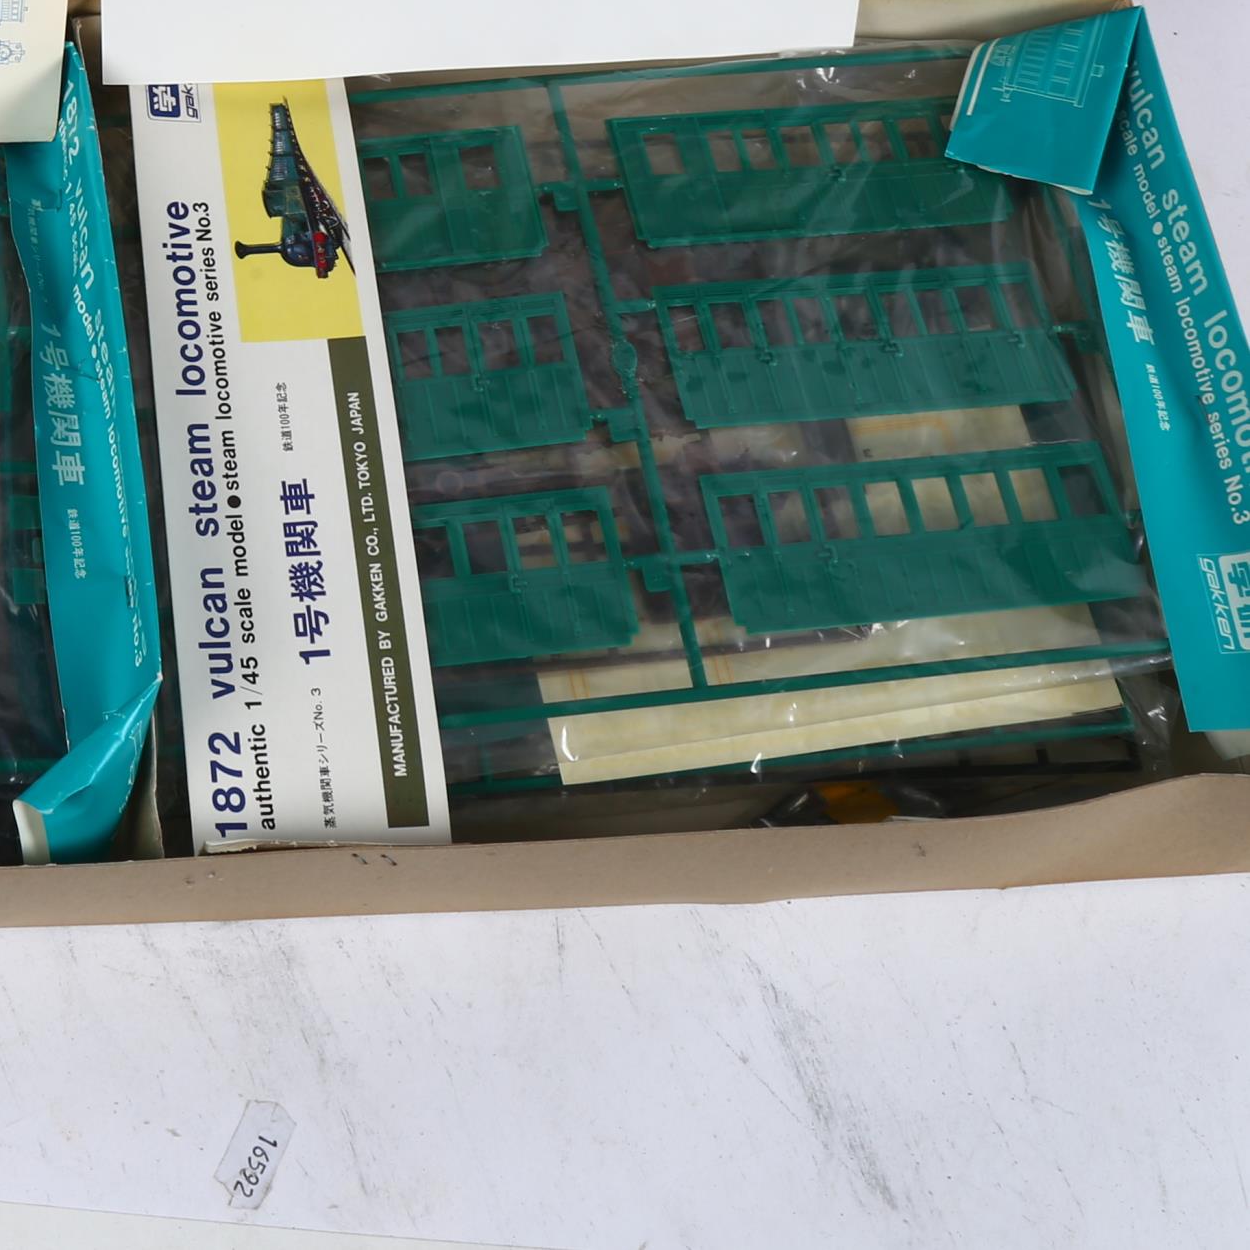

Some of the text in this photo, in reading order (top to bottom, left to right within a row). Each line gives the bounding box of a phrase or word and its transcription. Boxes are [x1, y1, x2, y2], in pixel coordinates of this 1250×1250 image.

[75, 179, 95, 290] vulcan
[1086, 198, 1156, 346] 1号機関車
[1133, 162, 1162, 219] model
[1157, 236, 1184, 294] steam
[1175, 296, 1216, 406] locomotive
[1207, 410, 1233, 470] series
[1223, 474, 1250, 526] No.3
[1162, 189, 1209, 296] steam
[1203, 309, 1250, 474] locomo
[39, 320, 86, 487] 1号機関車
[72, 283, 96, 343] model
[107, 421, 130, 539] locomotive
[275, 382, 294, 452] 鉄道100年記念
[347, 391, 365, 435] JAPAN
[162, 201, 248, 838] 1872 vulcan steam locomotive
[192, 201, 276, 831] authentic 1/45 scale model steam locomotive series No.3
[353, 441, 371, 490] TOKYO
[359, 492, 376, 523] LTD.
[66, 507, 87, 580] 鉄道100年記念
[280, 478, 332, 666] 1号機関車
[366, 562, 389, 623] GAKKEN
[378, 630, 393, 650] BY
[1198, 556, 1236, 651] gakken
[379, 656, 408, 778] MANUFACTURED
[233, 1135, 278, 1199] 16592
